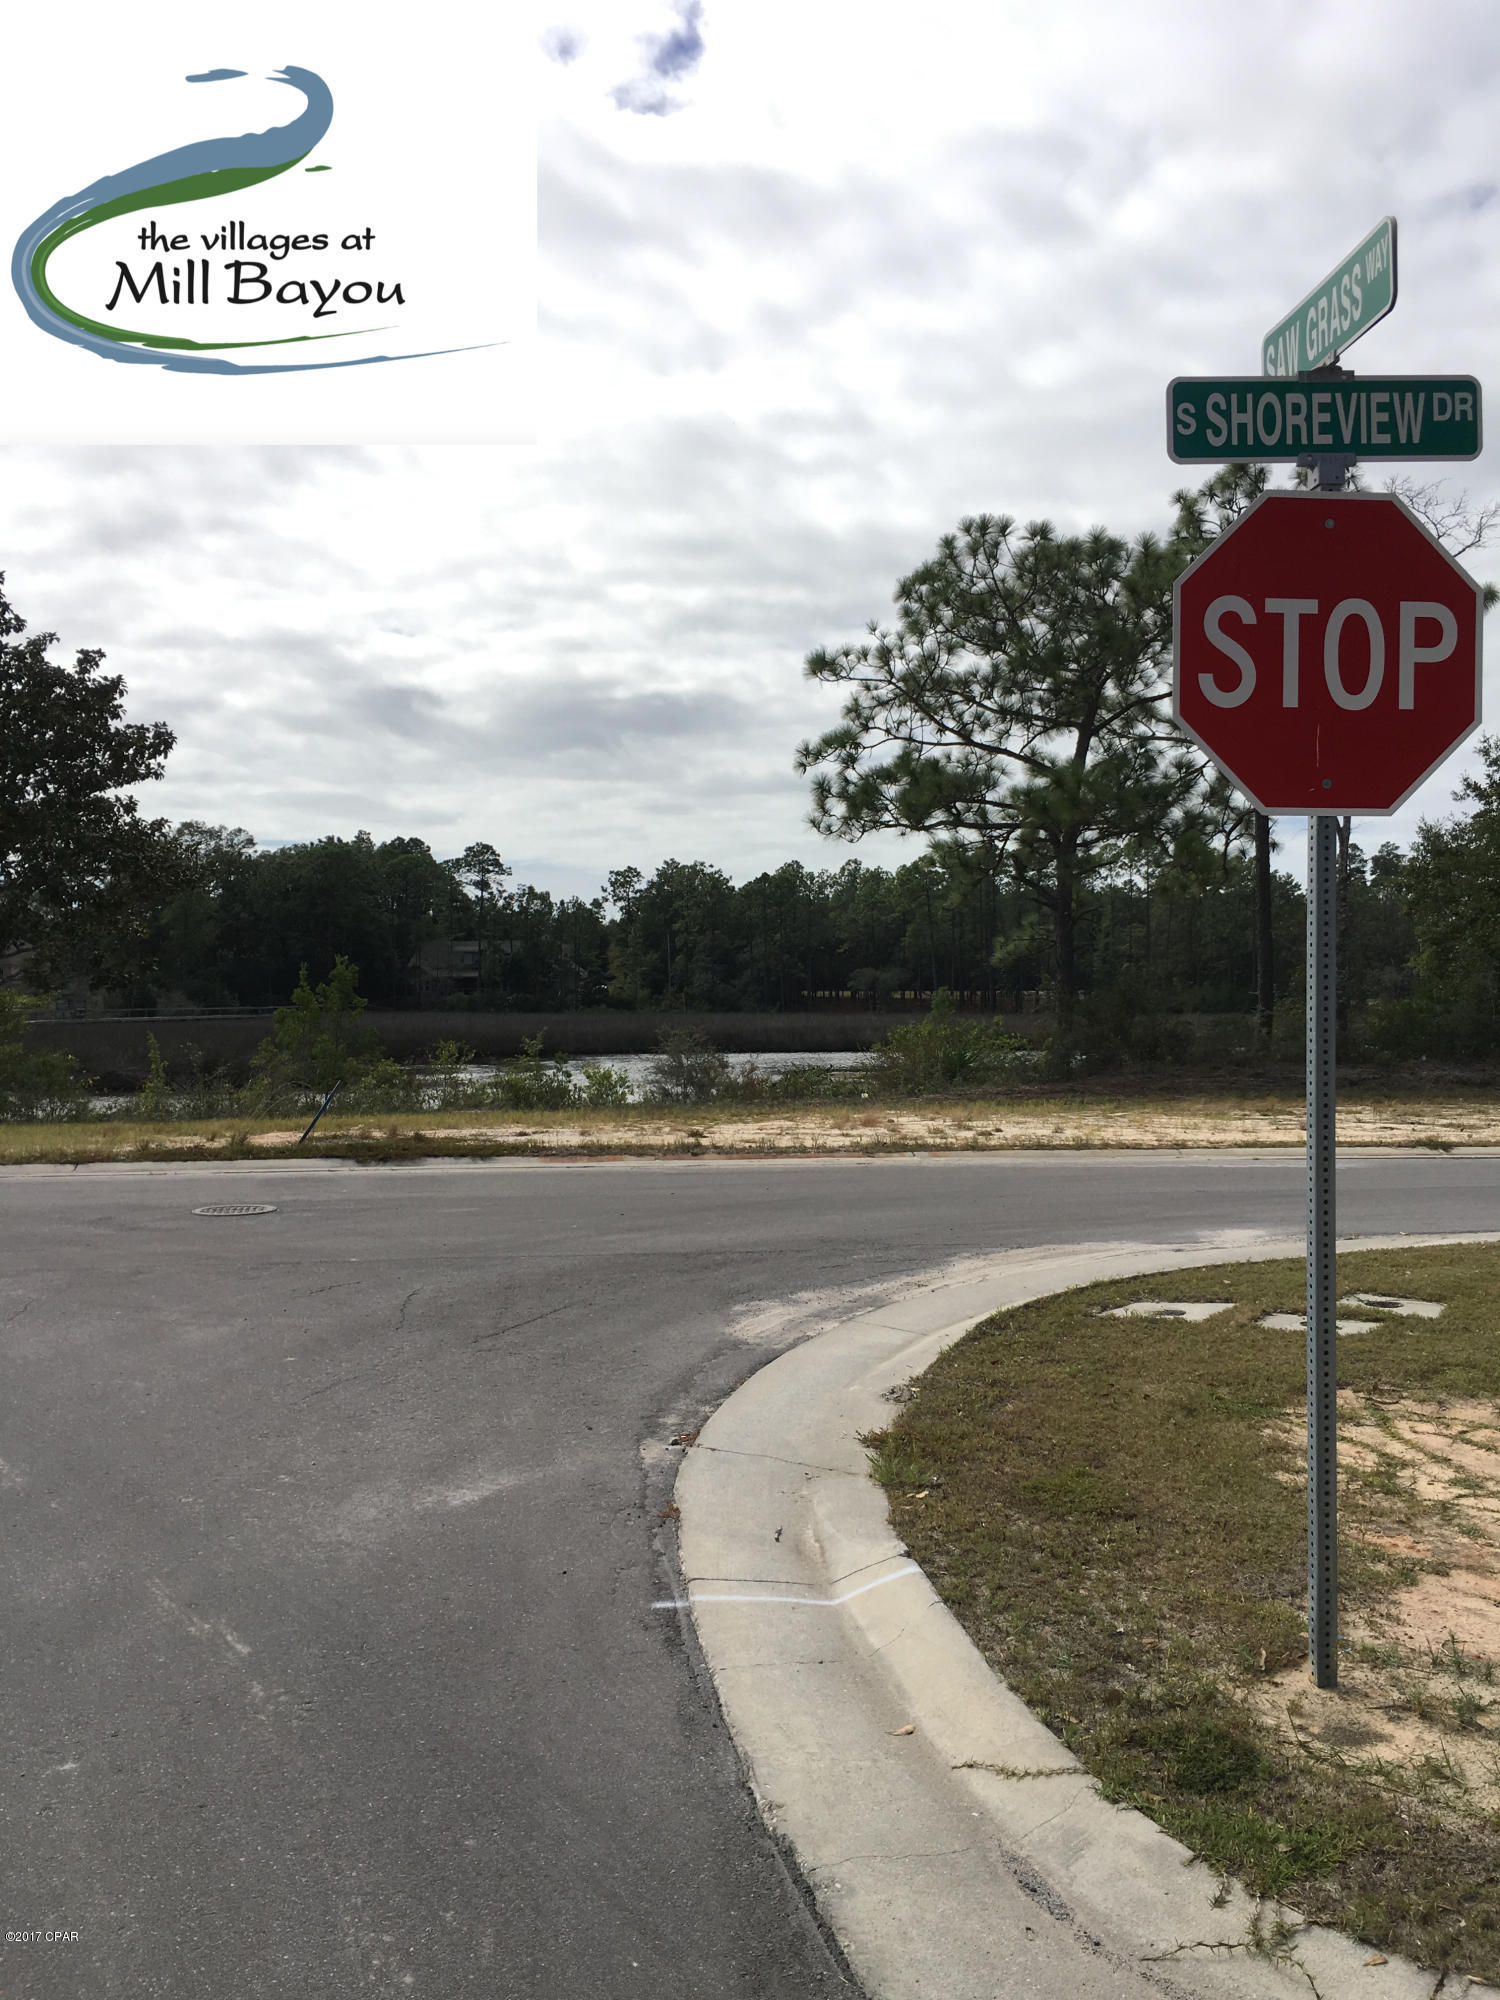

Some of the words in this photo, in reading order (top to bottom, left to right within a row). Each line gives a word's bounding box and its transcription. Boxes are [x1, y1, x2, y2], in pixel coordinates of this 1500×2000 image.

[1266, 321, 1300, 376] SAW
[1306, 263, 1363, 361] GRASS
[1365, 233, 1389, 284] WAY
[1176, 402, 1197, 435] S
[1206, 392, 1425, 447] SHOREVIEW
[1432, 392, 1474, 421] DR
[1198, 595, 1458, 711] STOP
